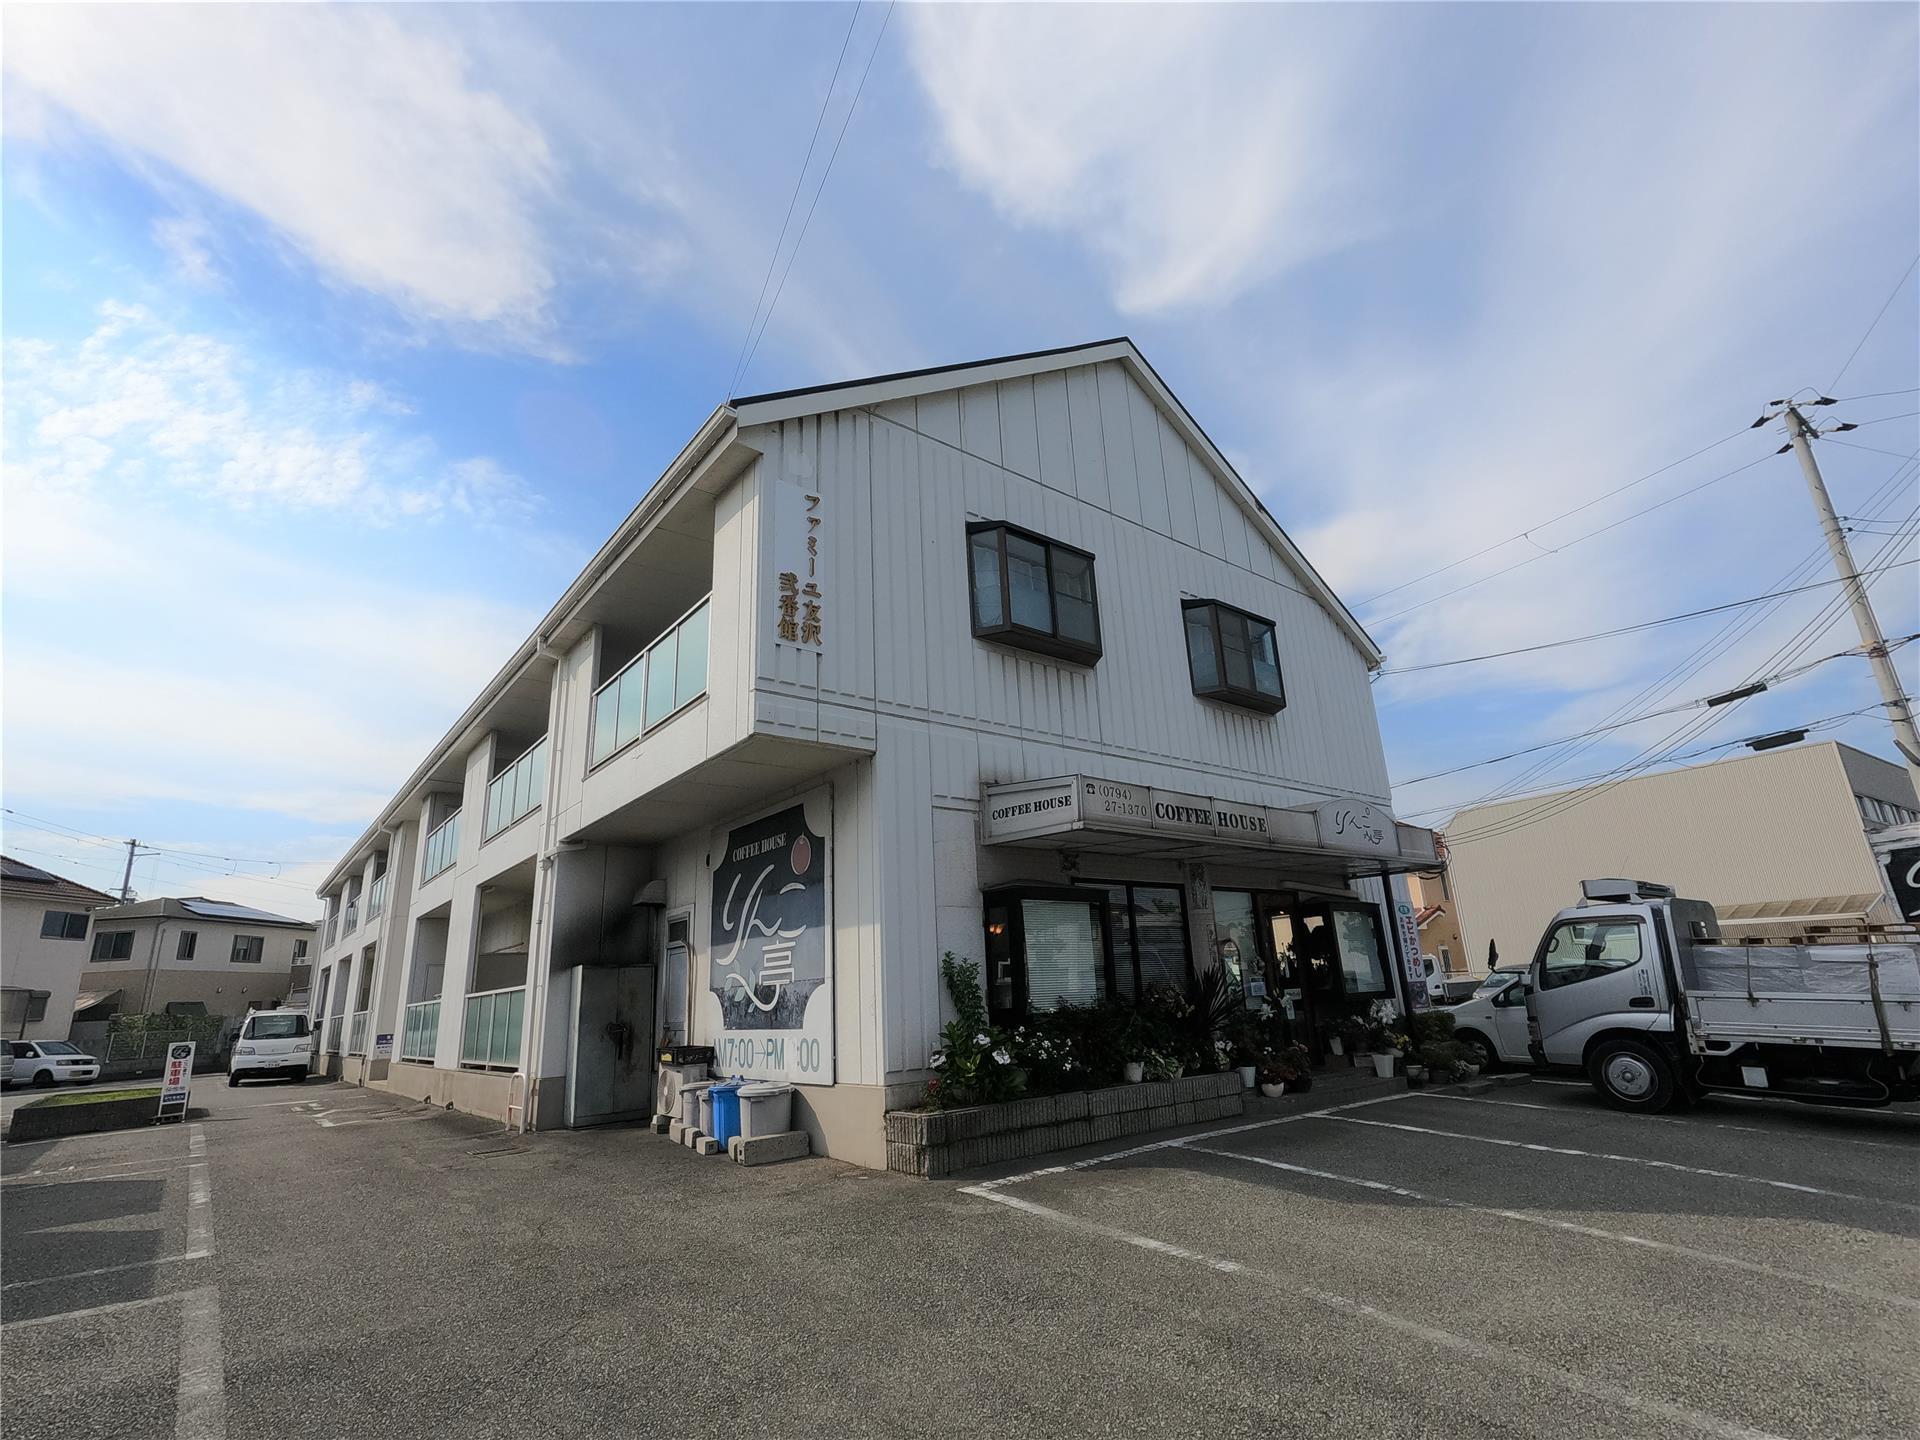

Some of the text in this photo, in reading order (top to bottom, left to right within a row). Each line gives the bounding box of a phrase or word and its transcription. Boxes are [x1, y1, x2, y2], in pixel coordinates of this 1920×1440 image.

[801, 494, 823, 646] ファミーユ友沢
[1098, 785, 1132, 801] (0794)
[992, 795, 1072, 821] COFFEE HOUSE
[1104, 800, 1147, 817] 27-1370
[1155, 802, 1268, 833] COFFEE HOUSE
[732, 832, 787, 863] COFFEE HOUSE
[1405, 915, 1422, 979] エビかつめし
[168, 1061, 183, 1086] 駐車場
